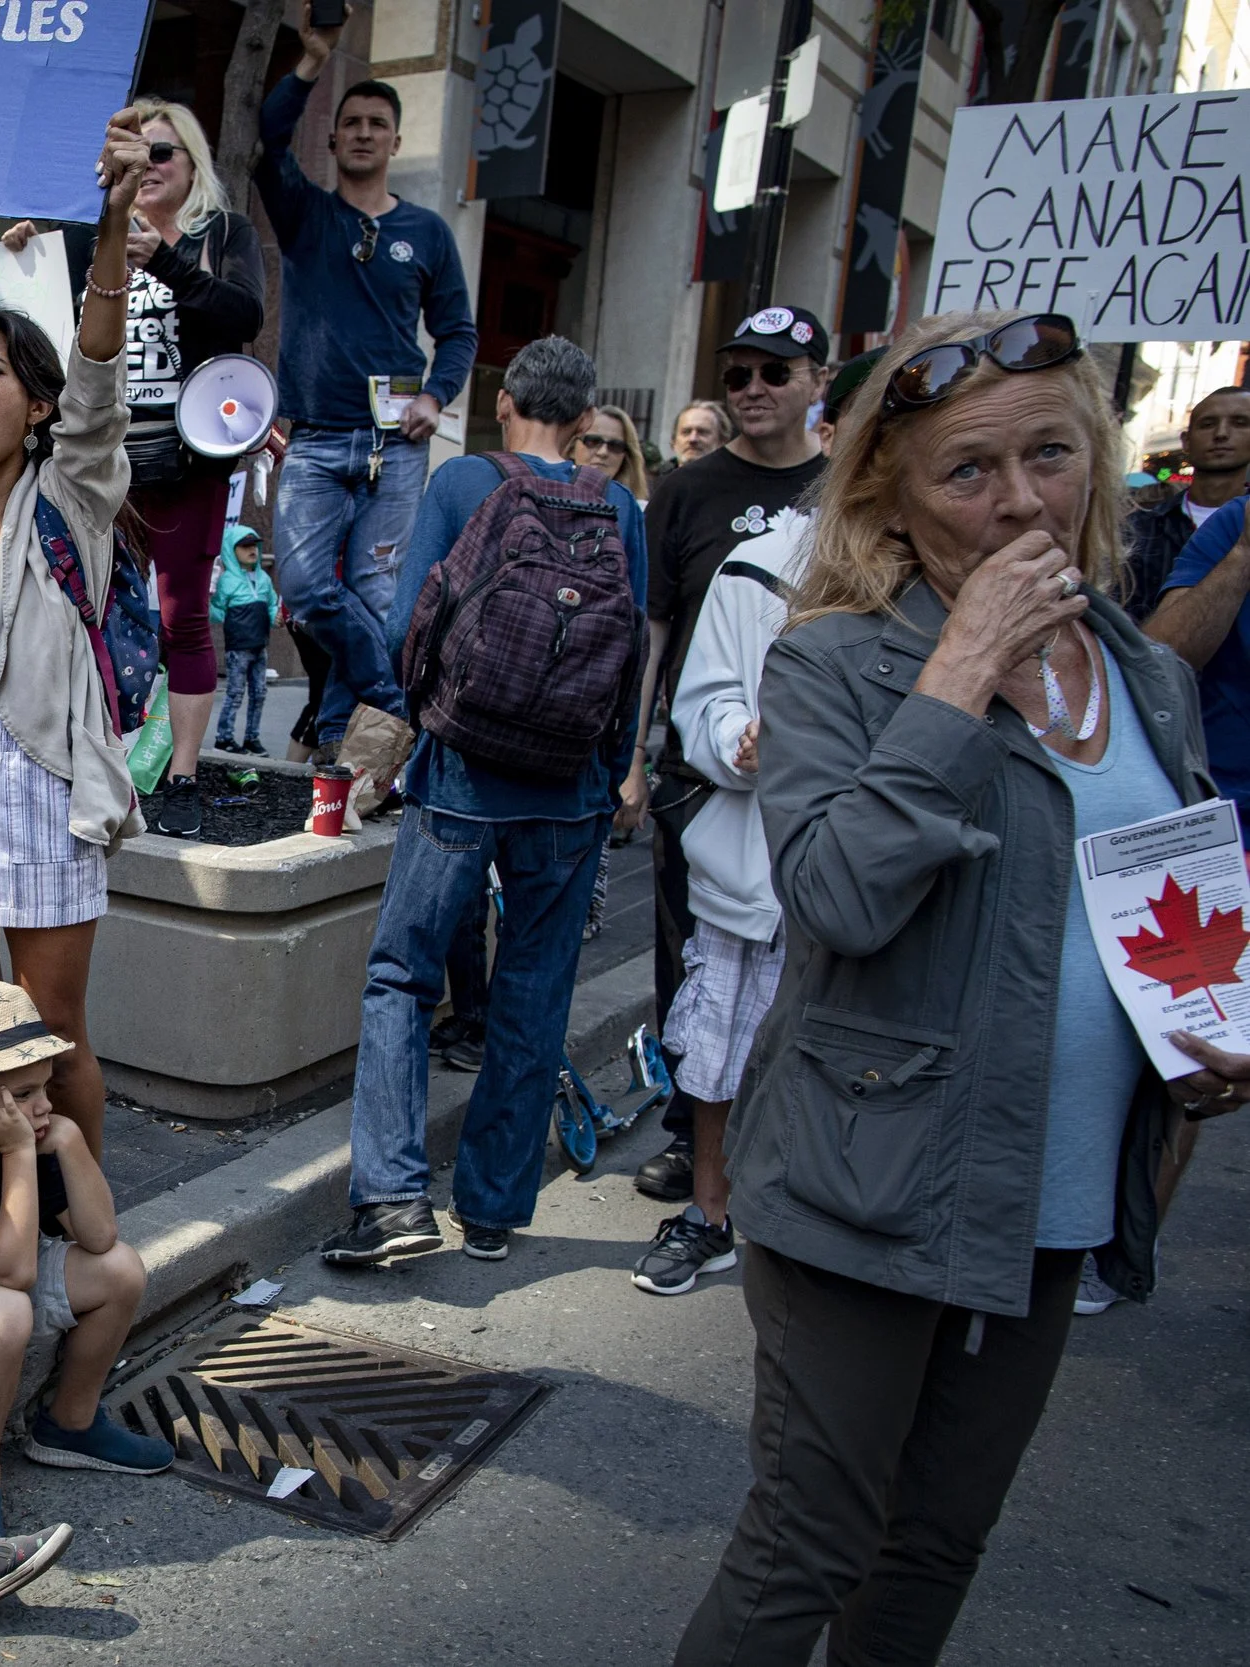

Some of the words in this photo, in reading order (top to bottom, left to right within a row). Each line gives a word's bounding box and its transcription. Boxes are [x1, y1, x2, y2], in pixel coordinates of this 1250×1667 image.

[984, 96, 1239, 178] MAKE
[966, 174, 1248, 252] CANADA
[127, 281, 178, 318] gle
[126, 311, 180, 342] ret
[126, 342, 181, 380] ED
[313, 799, 343, 817] tons
[1183, 813, 1217, 828] ABUSE
[1118, 863, 1164, 879] ISOLATION
[1111, 910, 1129, 920] GAS
[1162, 997, 1209, 1013] ECONOMIC
[1184, 1006, 1214, 1019] ABUSE
